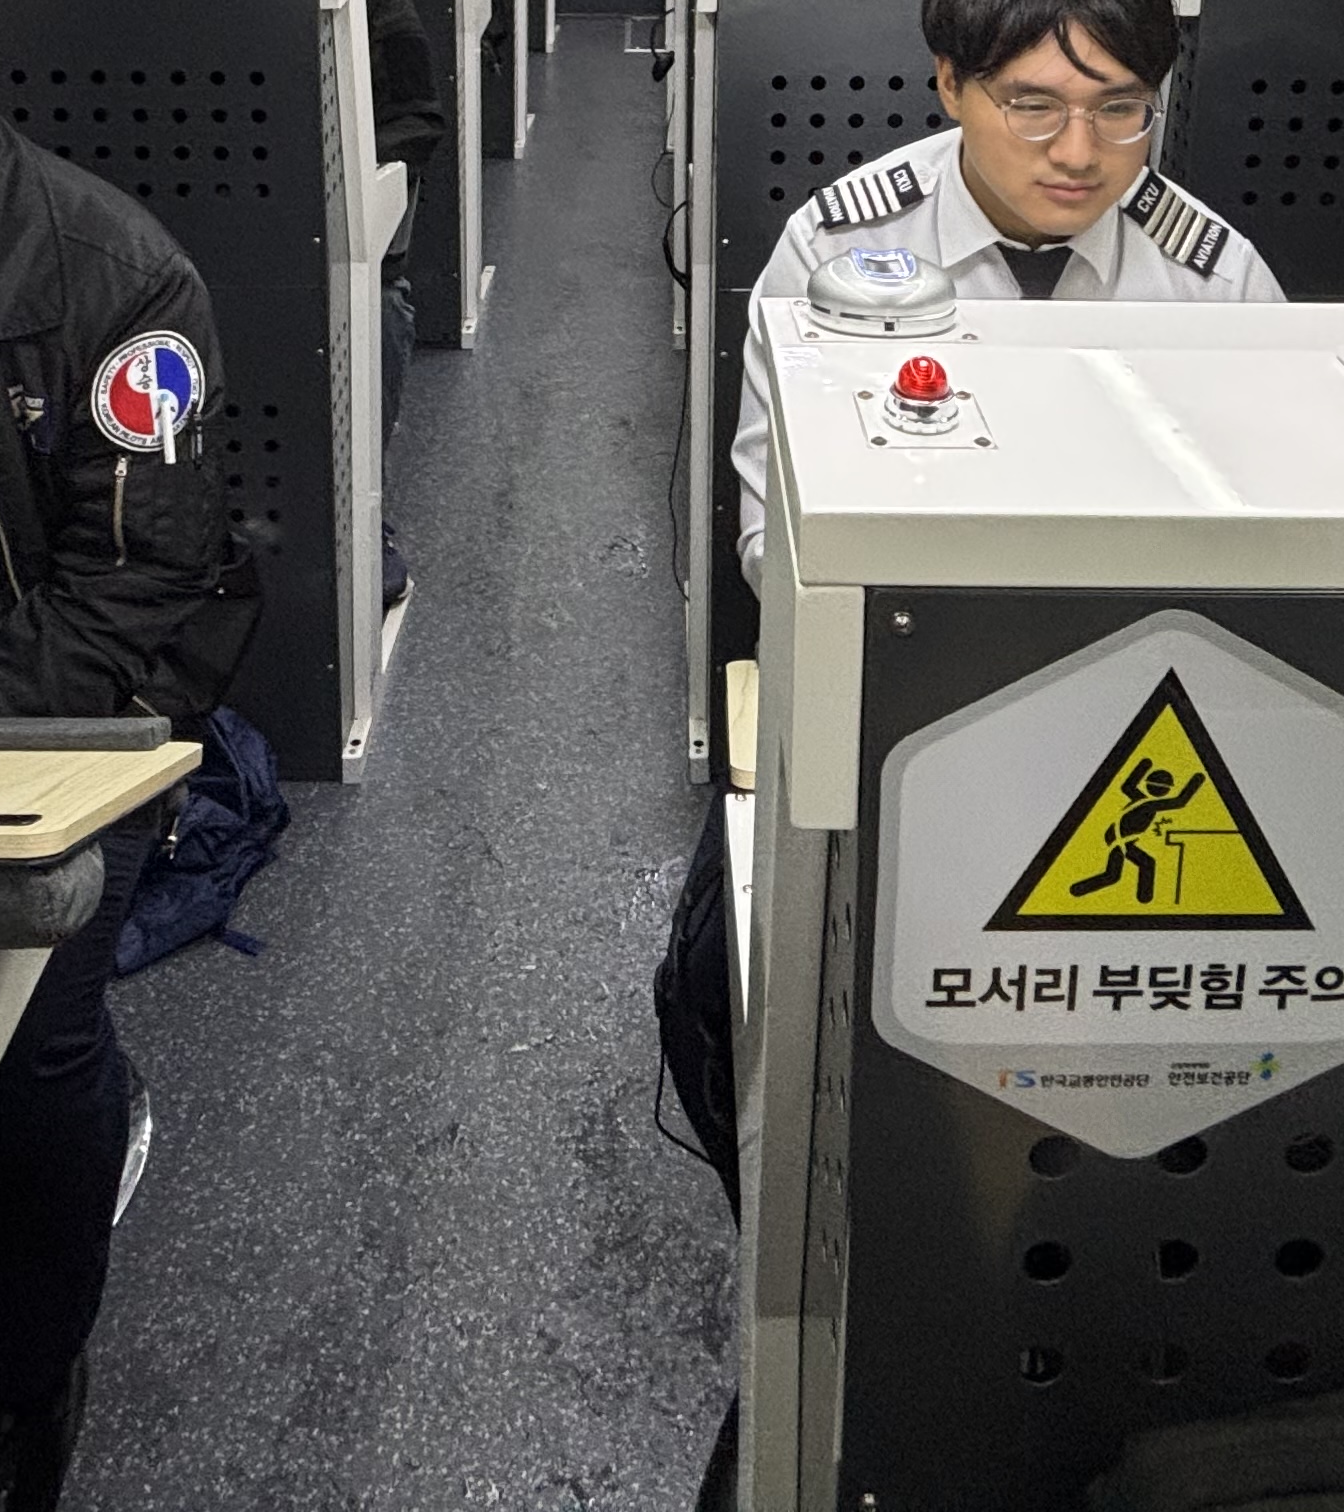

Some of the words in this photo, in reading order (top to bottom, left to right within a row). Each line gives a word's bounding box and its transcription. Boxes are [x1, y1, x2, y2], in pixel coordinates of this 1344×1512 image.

[893, 169, 914, 193] CKU
[1137, 182, 1160, 214] CKU
[1193, 222, 1224, 269] AVIATION
[925, 965, 1079, 1012] 모서리
[1093, 964, 1246, 1012] 부딪힘
